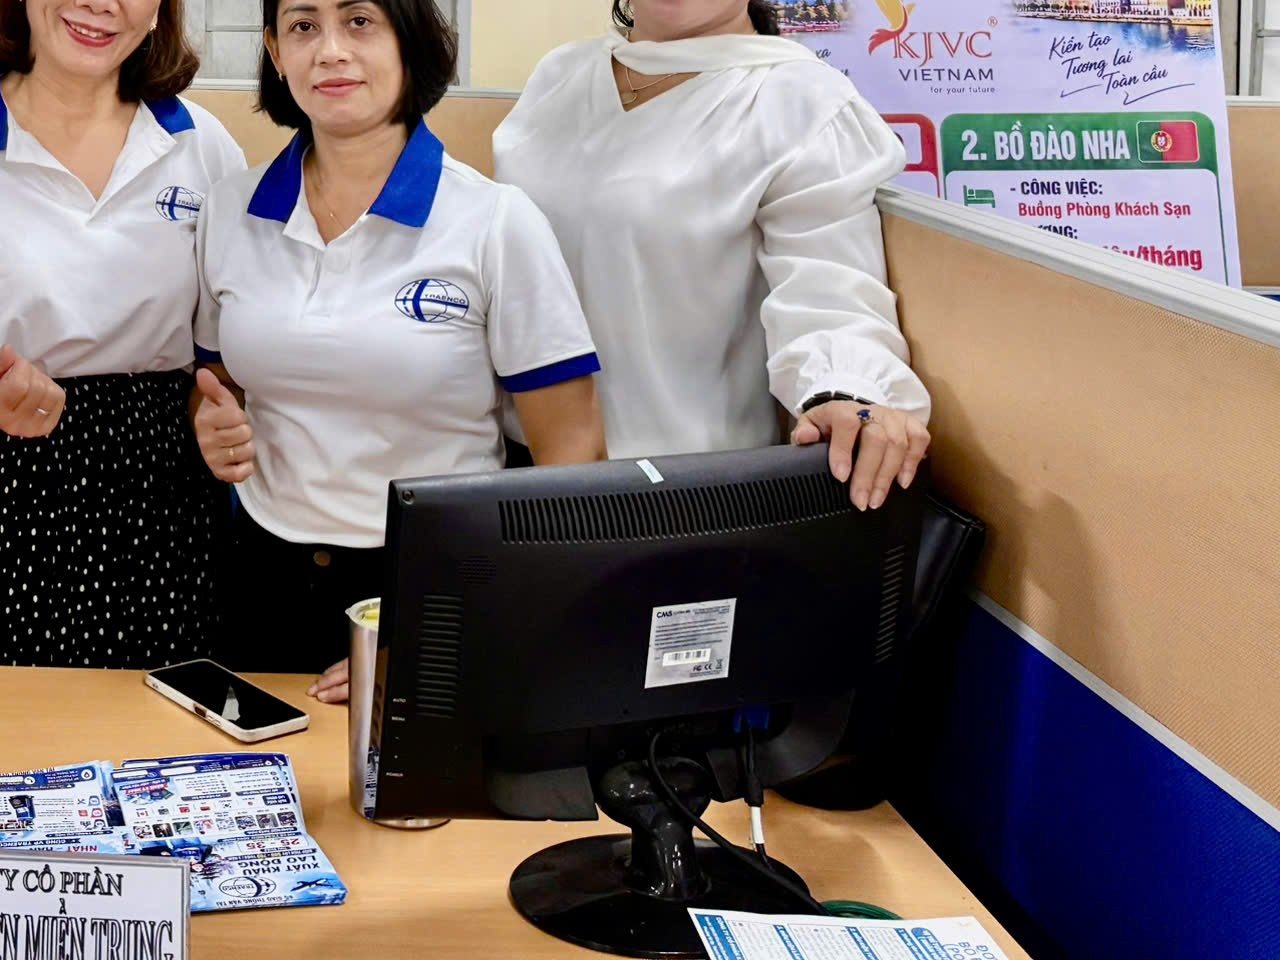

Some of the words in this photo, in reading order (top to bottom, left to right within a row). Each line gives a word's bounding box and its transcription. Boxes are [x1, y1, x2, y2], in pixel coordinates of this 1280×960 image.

[893, 31, 992, 67] KJVC
[1088, 31, 1112, 51] tạo
[1061, 56, 1107, 79] Tương
[1113, 48, 1133, 66] lai
[898, 68, 994, 81] VIETNAM
[1102, 71, 1139, 95] Toàn
[930, 86, 943, 94] for
[946, 87, 965, 95] your
[969, 86, 996, 94] future
[961, 130, 988, 160] 2.
[994, 121, 1024, 161] BỒ
[1030, 125, 1076, 160] ĐÀO
[1082, 130, 1130, 160] NHA
[1021, 179, 1061, 195] CÔNG
[1067, 178, 1103, 198] VIỆC:
[1018, 200, 1062, 219] Buồng
[1067, 202, 1111, 219] Phòng
[1115, 202, 1159, 216] Khách
[1164, 203, 1191, 218] Sạn
[280, 838, 300, 846] 25
[238, 859, 281, 869] ĐỘNG
[287, 855, 316, 864] LAO
[59, 866, 124, 896] PHẦN
[90, 918, 174, 960] TRUNG
